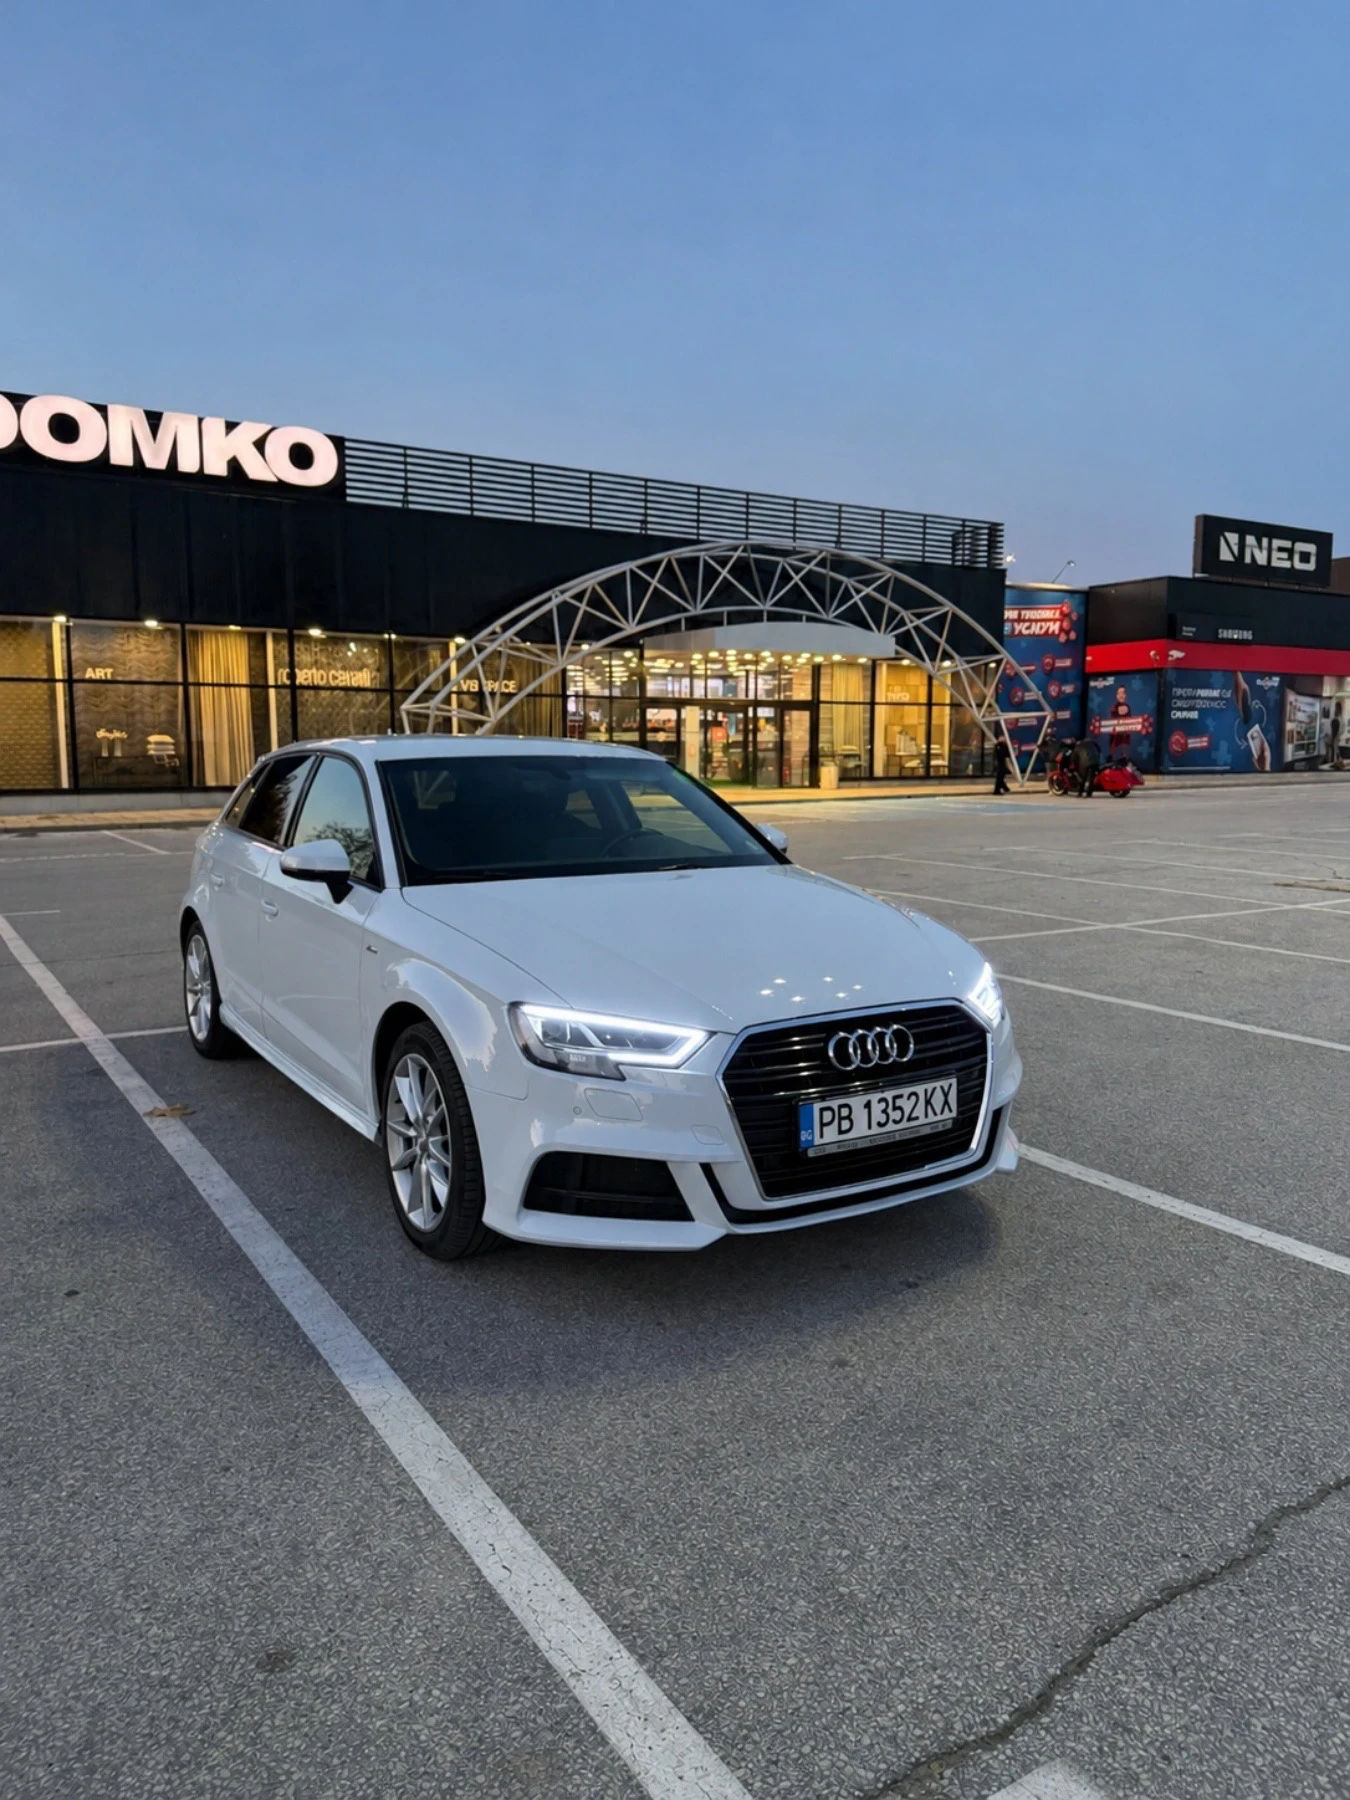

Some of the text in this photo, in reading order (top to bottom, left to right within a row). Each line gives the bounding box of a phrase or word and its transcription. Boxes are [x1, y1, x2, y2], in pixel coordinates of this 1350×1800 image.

[0, 394, 338, 487] OMKO
[1244, 534, 1317, 572] NEO
[85, 667, 113, 680] ART
[818, 1103, 854, 1139] PB
